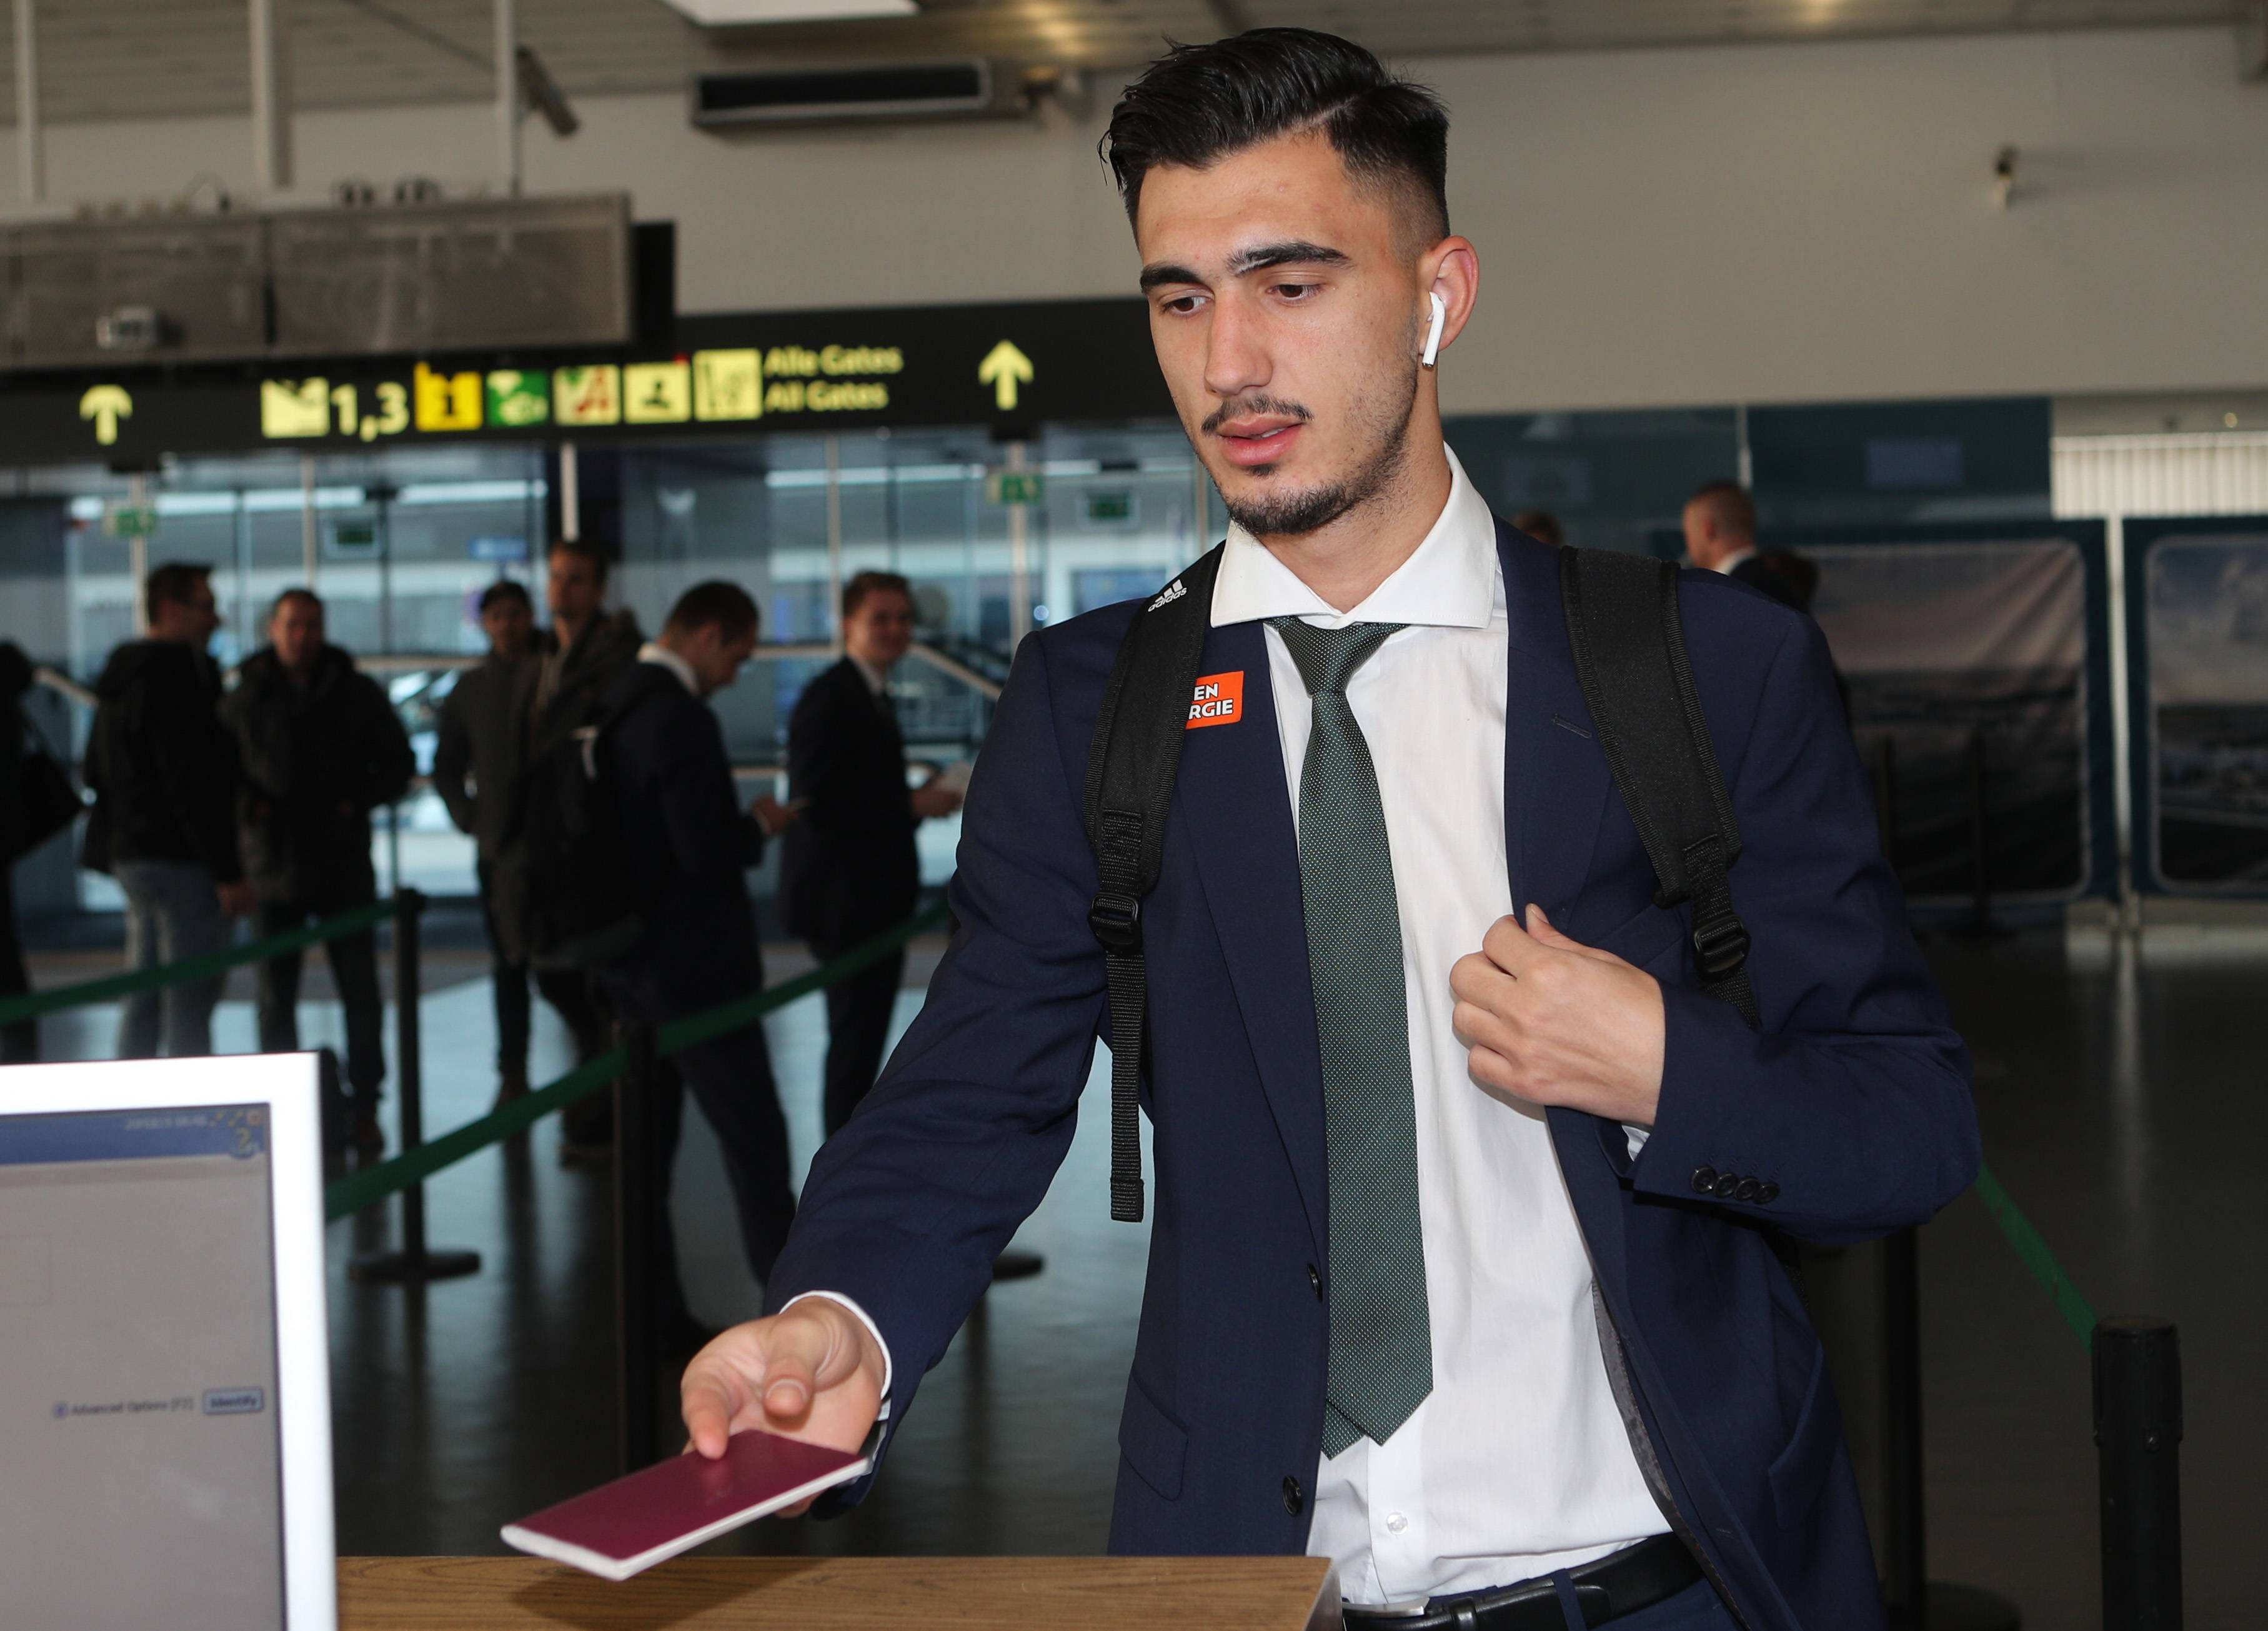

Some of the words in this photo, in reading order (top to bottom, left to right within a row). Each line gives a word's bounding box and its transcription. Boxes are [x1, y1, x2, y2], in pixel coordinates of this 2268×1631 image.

[764, 346, 818, 377] Alle
[820, 344, 903, 375] Gates
[331, 382, 409, 442] 1,3
[765, 382, 805, 412] All
[806, 381, 888, 411] Gates
[1148, 587, 1187, 612] adidas
[210, 1395, 257, 1409] Identify
